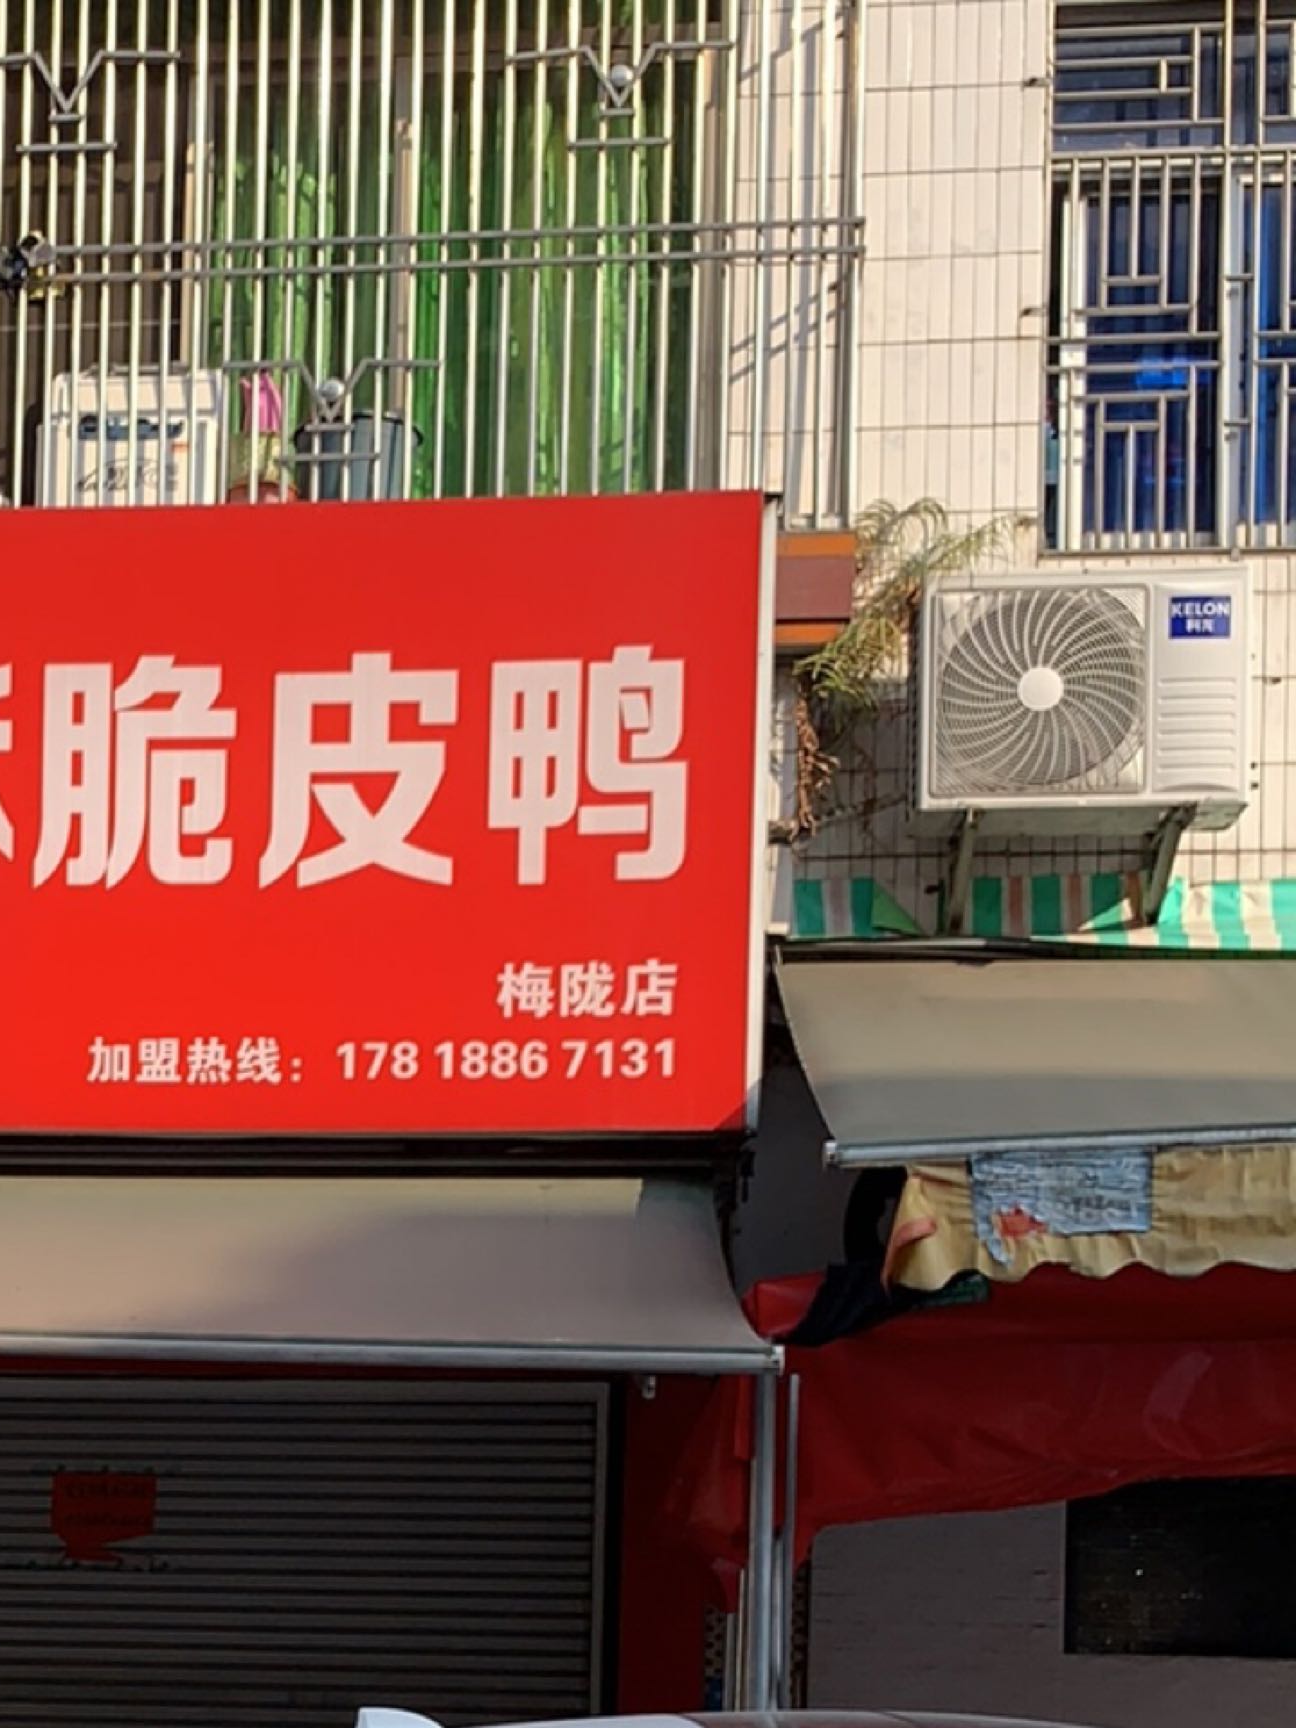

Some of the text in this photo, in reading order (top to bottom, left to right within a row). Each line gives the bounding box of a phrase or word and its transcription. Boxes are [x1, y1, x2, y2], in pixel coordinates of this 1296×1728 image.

[1171, 602, 1230, 617] KELON
[496, 958, 678, 1018] 梅陇店
[87, 1036, 674, 1084] 加盟热线： 178 1886 7131
